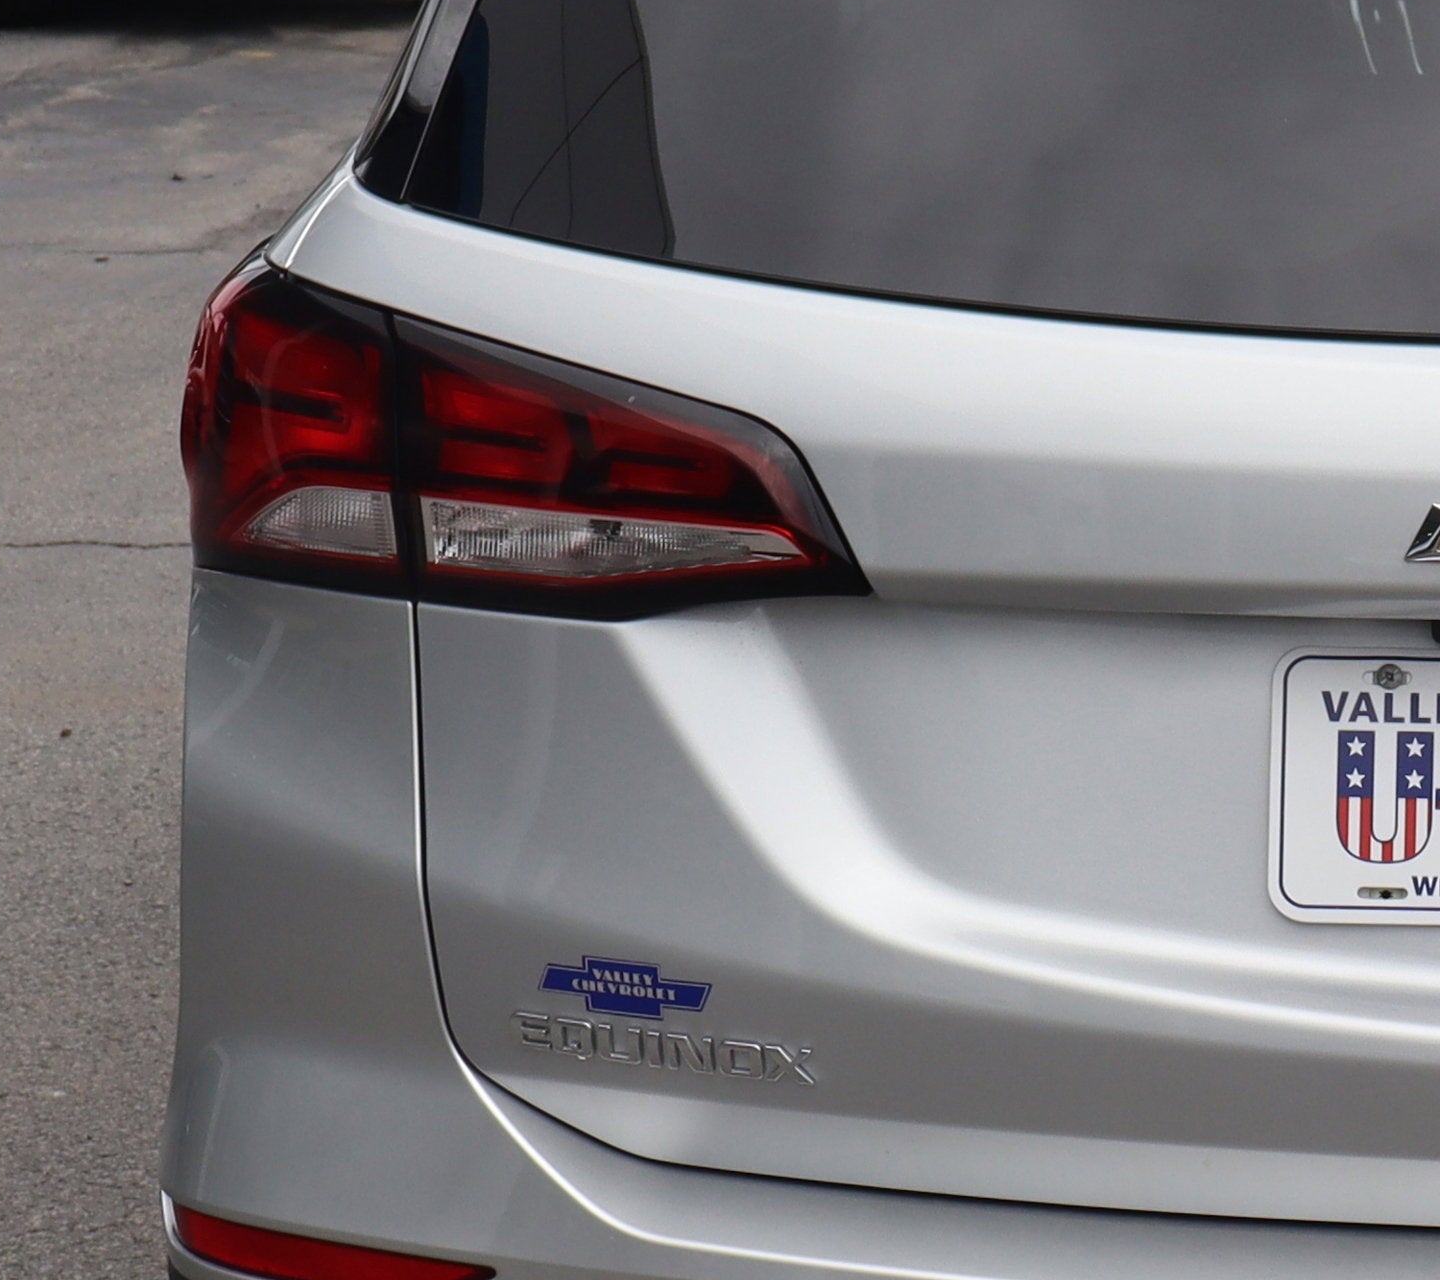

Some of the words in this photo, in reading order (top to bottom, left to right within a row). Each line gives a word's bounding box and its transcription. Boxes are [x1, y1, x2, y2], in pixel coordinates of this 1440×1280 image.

[592, 968, 654, 986] VALLEY
[572, 978, 676, 1002] CHEVROLET
[514, 1010, 815, 1086] EQUINOX
